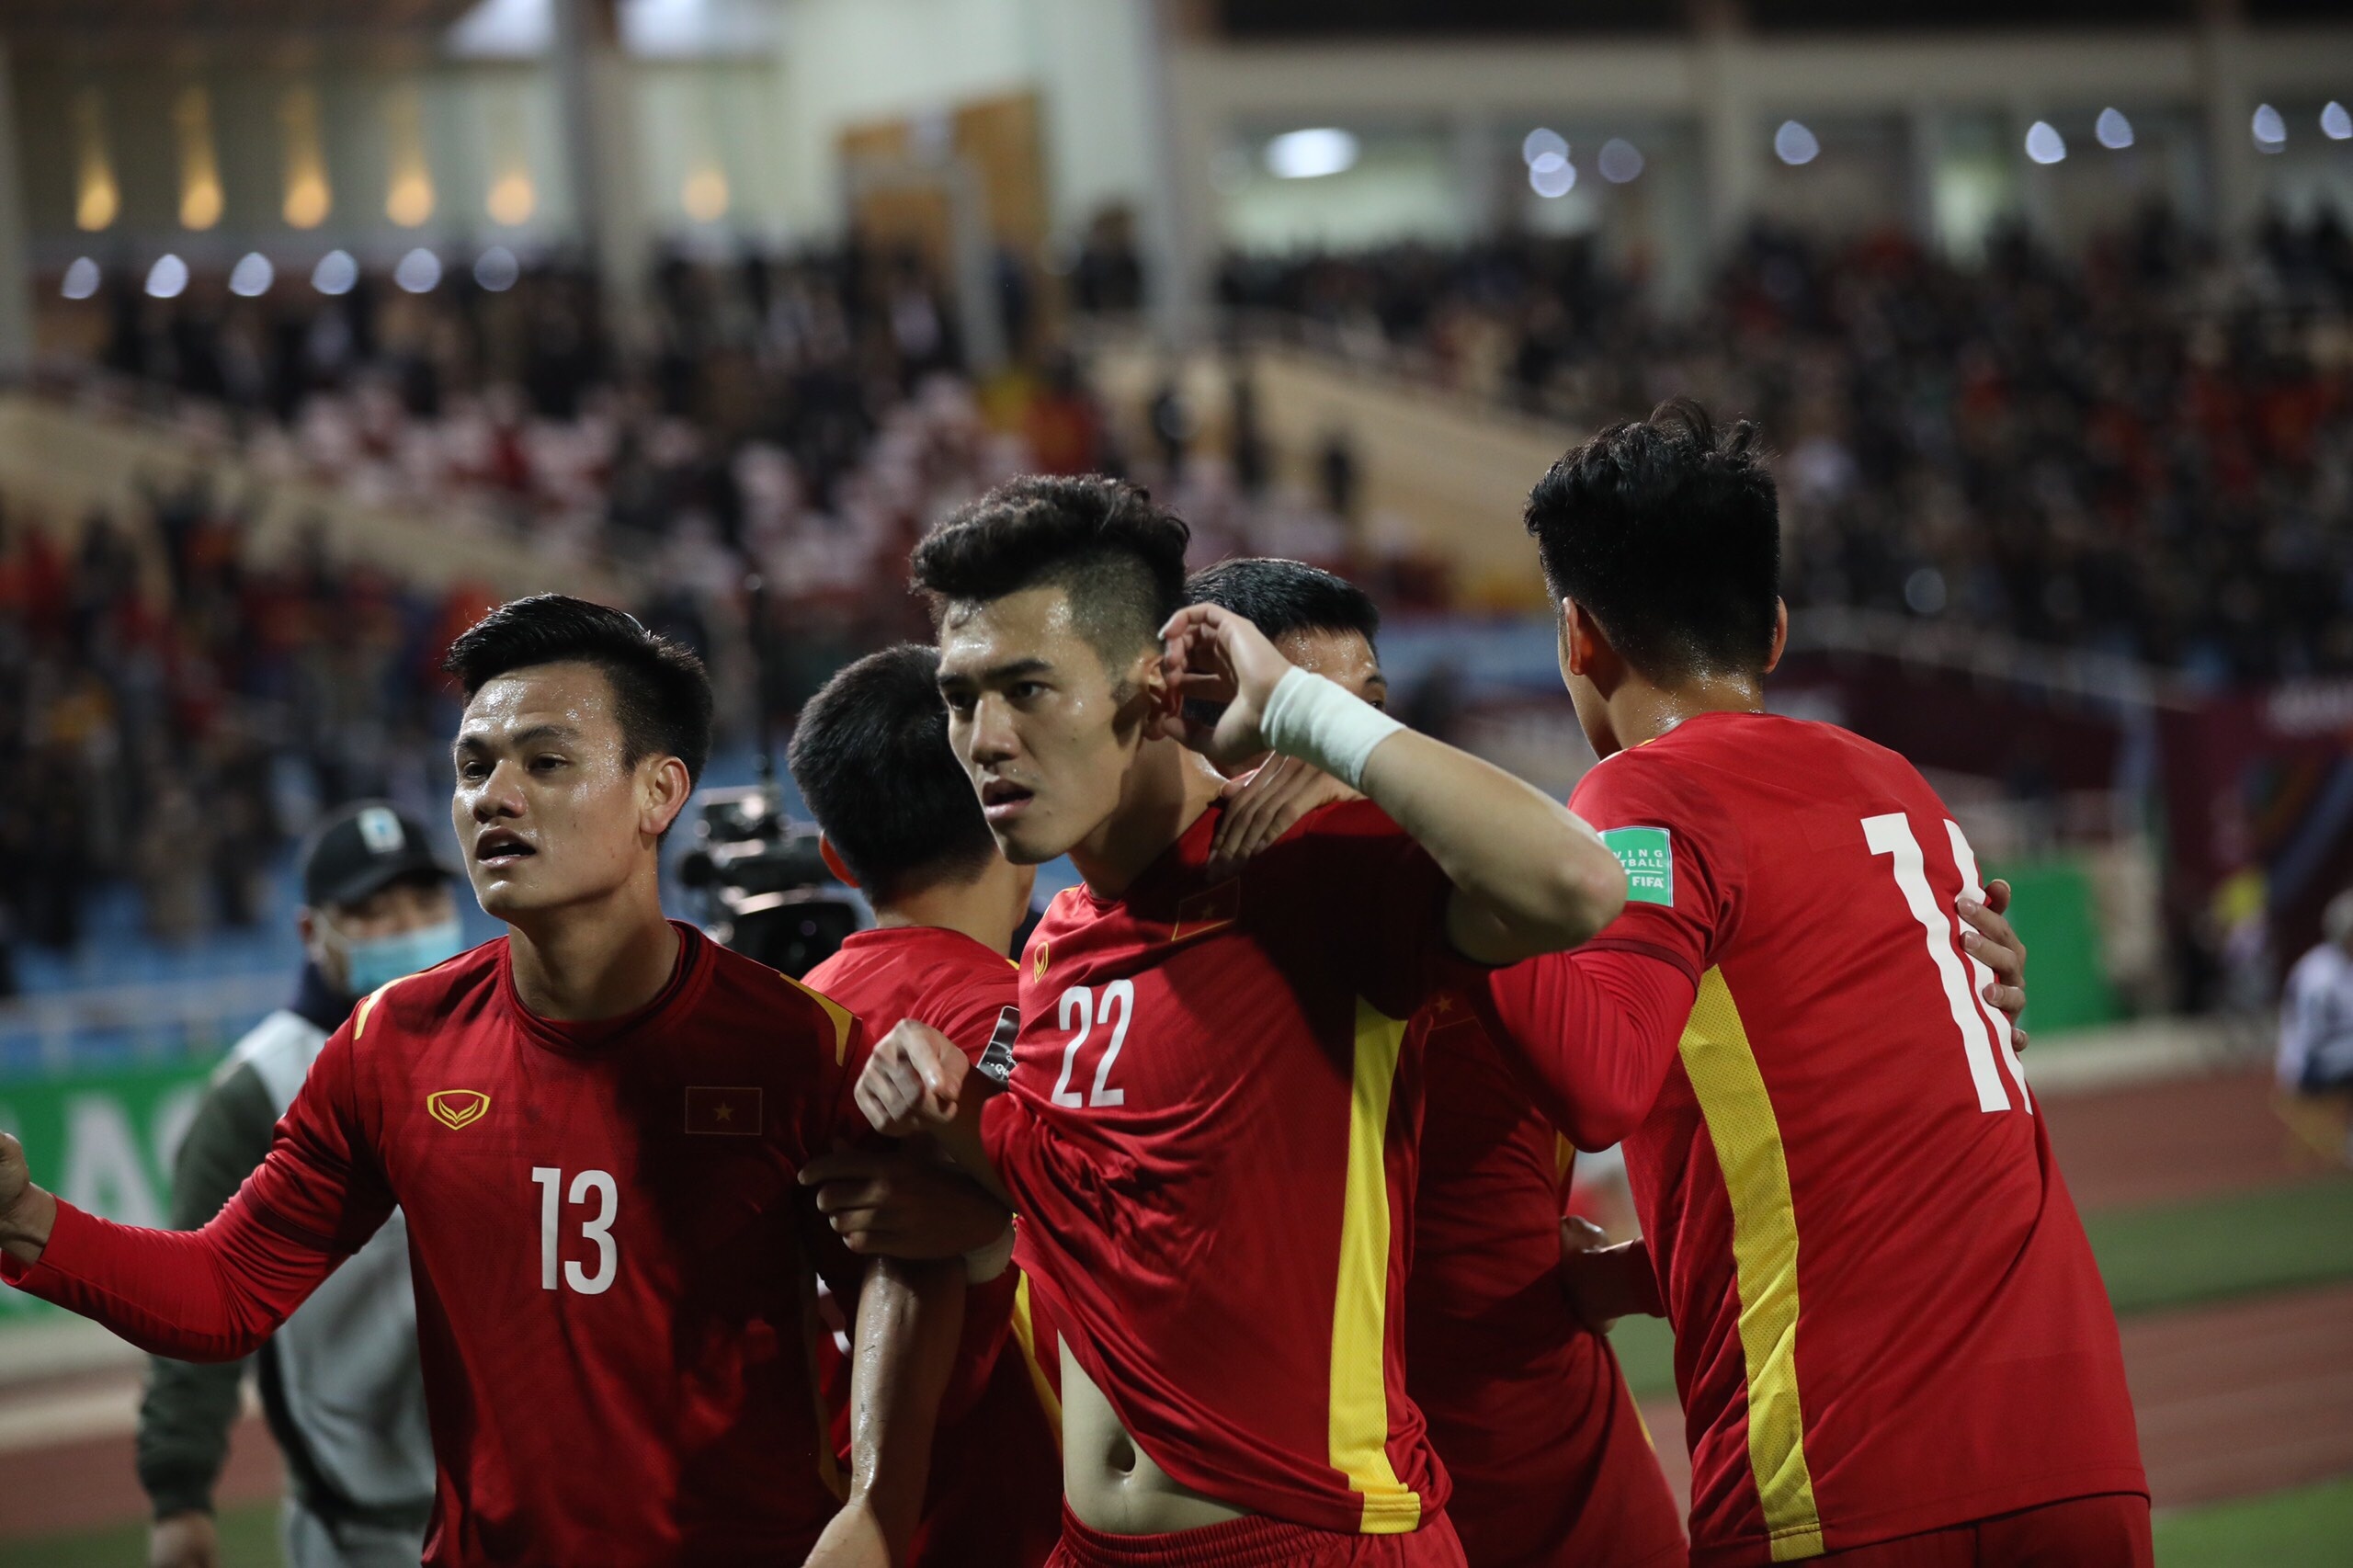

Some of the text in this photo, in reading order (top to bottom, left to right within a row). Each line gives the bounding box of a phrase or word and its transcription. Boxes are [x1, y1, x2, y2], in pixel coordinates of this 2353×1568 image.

[1613, 849, 1664, 859] VING
[1620, 858, 1664, 868] TBALL
[1631, 876, 1664, 889] FIFA
[1051, 979, 1135, 1108] 22
[531, 1166, 619, 1295] 13
